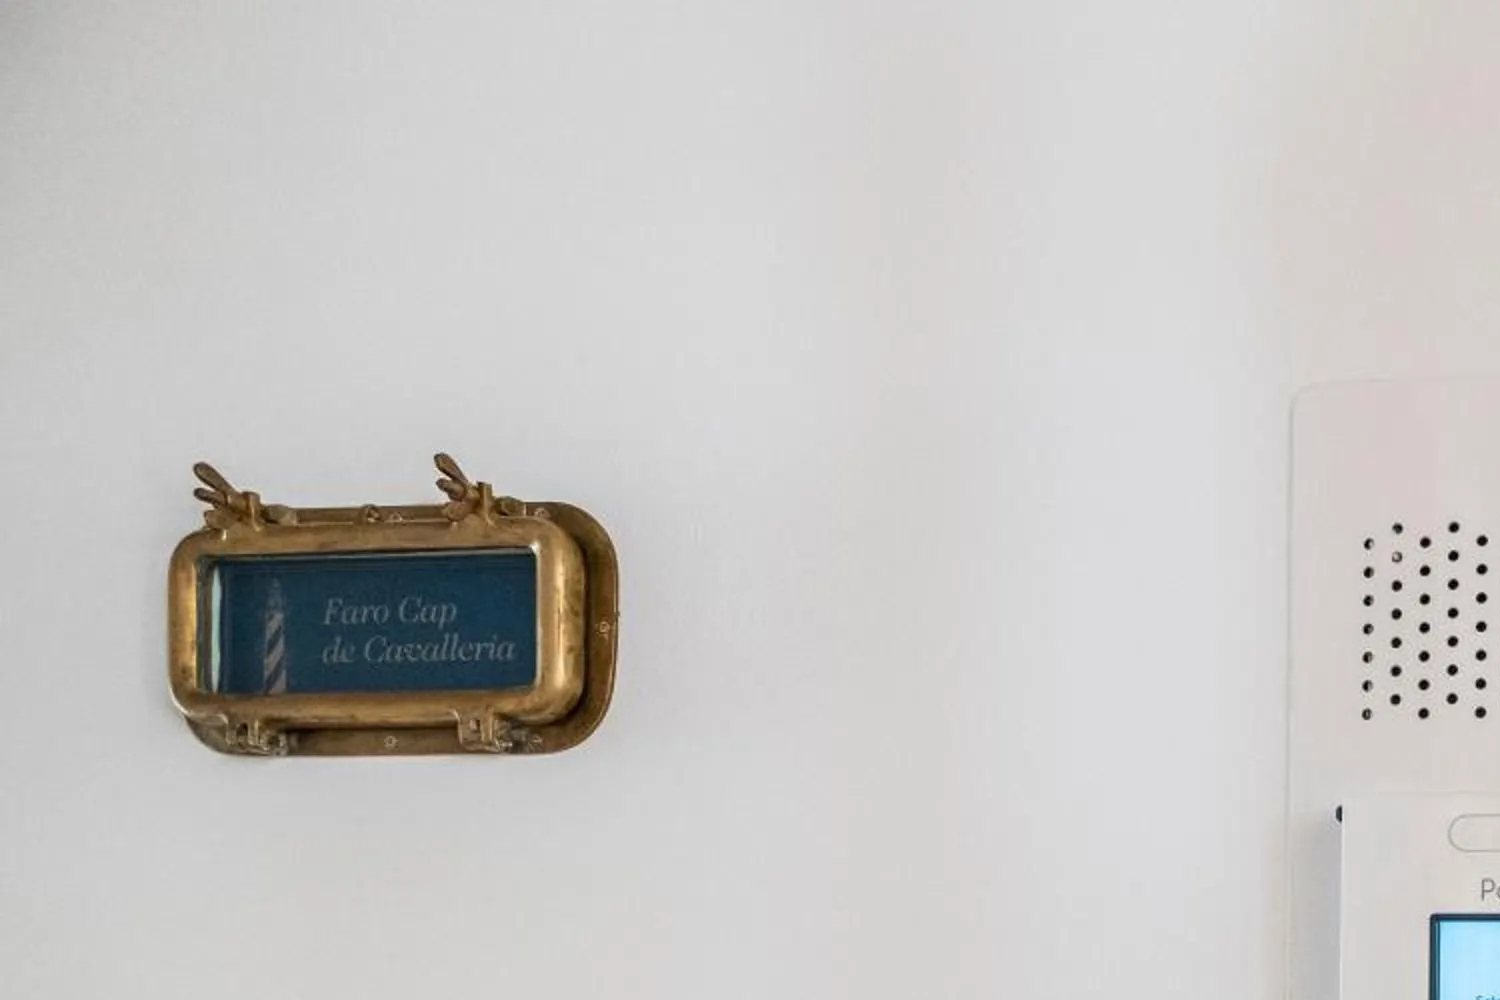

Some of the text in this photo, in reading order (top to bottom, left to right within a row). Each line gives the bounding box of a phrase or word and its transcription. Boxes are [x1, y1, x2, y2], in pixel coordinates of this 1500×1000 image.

[323, 597, 458, 630] Faro Cap
[321, 631, 516, 664] de Cavalleria
